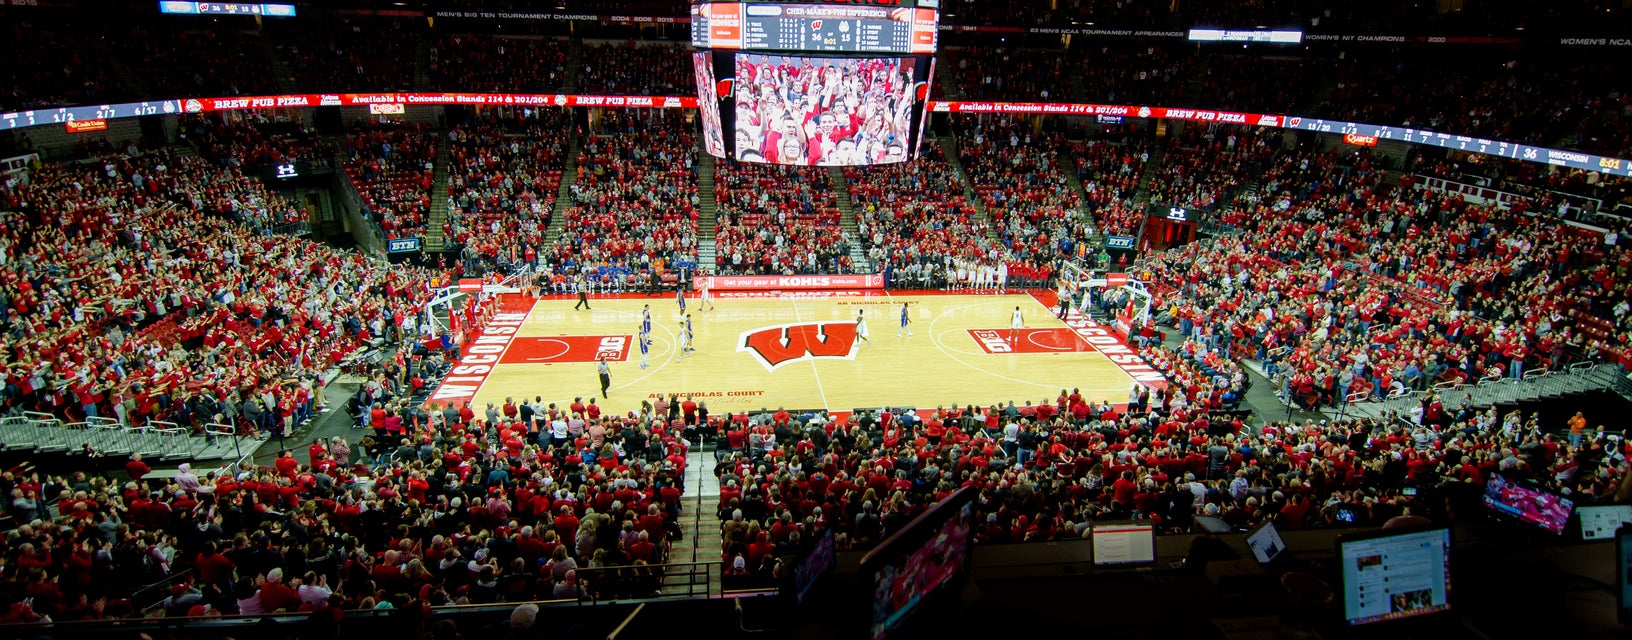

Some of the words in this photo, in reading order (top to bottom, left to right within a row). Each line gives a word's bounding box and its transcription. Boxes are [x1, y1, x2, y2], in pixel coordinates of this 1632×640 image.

[812, 33, 822, 41] 36
[214, 99, 250, 108] BREW
[252, 98, 274, 107] PUB
[277, 97, 308, 106] PIZZA
[96, 110, 115, 118] 2/7
[134, 106, 156, 115] 6/17
[1166, 109, 1194, 118] BREW
[1195, 112, 1215, 120] PUB
[1216, 113, 1245, 122] PIZZA
[10, 119, 16, 127] 3
[29, 116, 35, 125] 3
[1308, 122, 1331, 131] 15/20
[1375, 129, 1392, 138] 5/5
[1348, 134, 1374, 143] Quartz
[1524, 148, 1537, 159] 36
[1548, 150, 1589, 163] WISCONSIN
[1600, 157, 1620, 169] 8:01
[392, 241, 415, 250] BTN
[780, 278, 830, 286] KOHL'S
[432, 313, 526, 400] WISCONSIN
